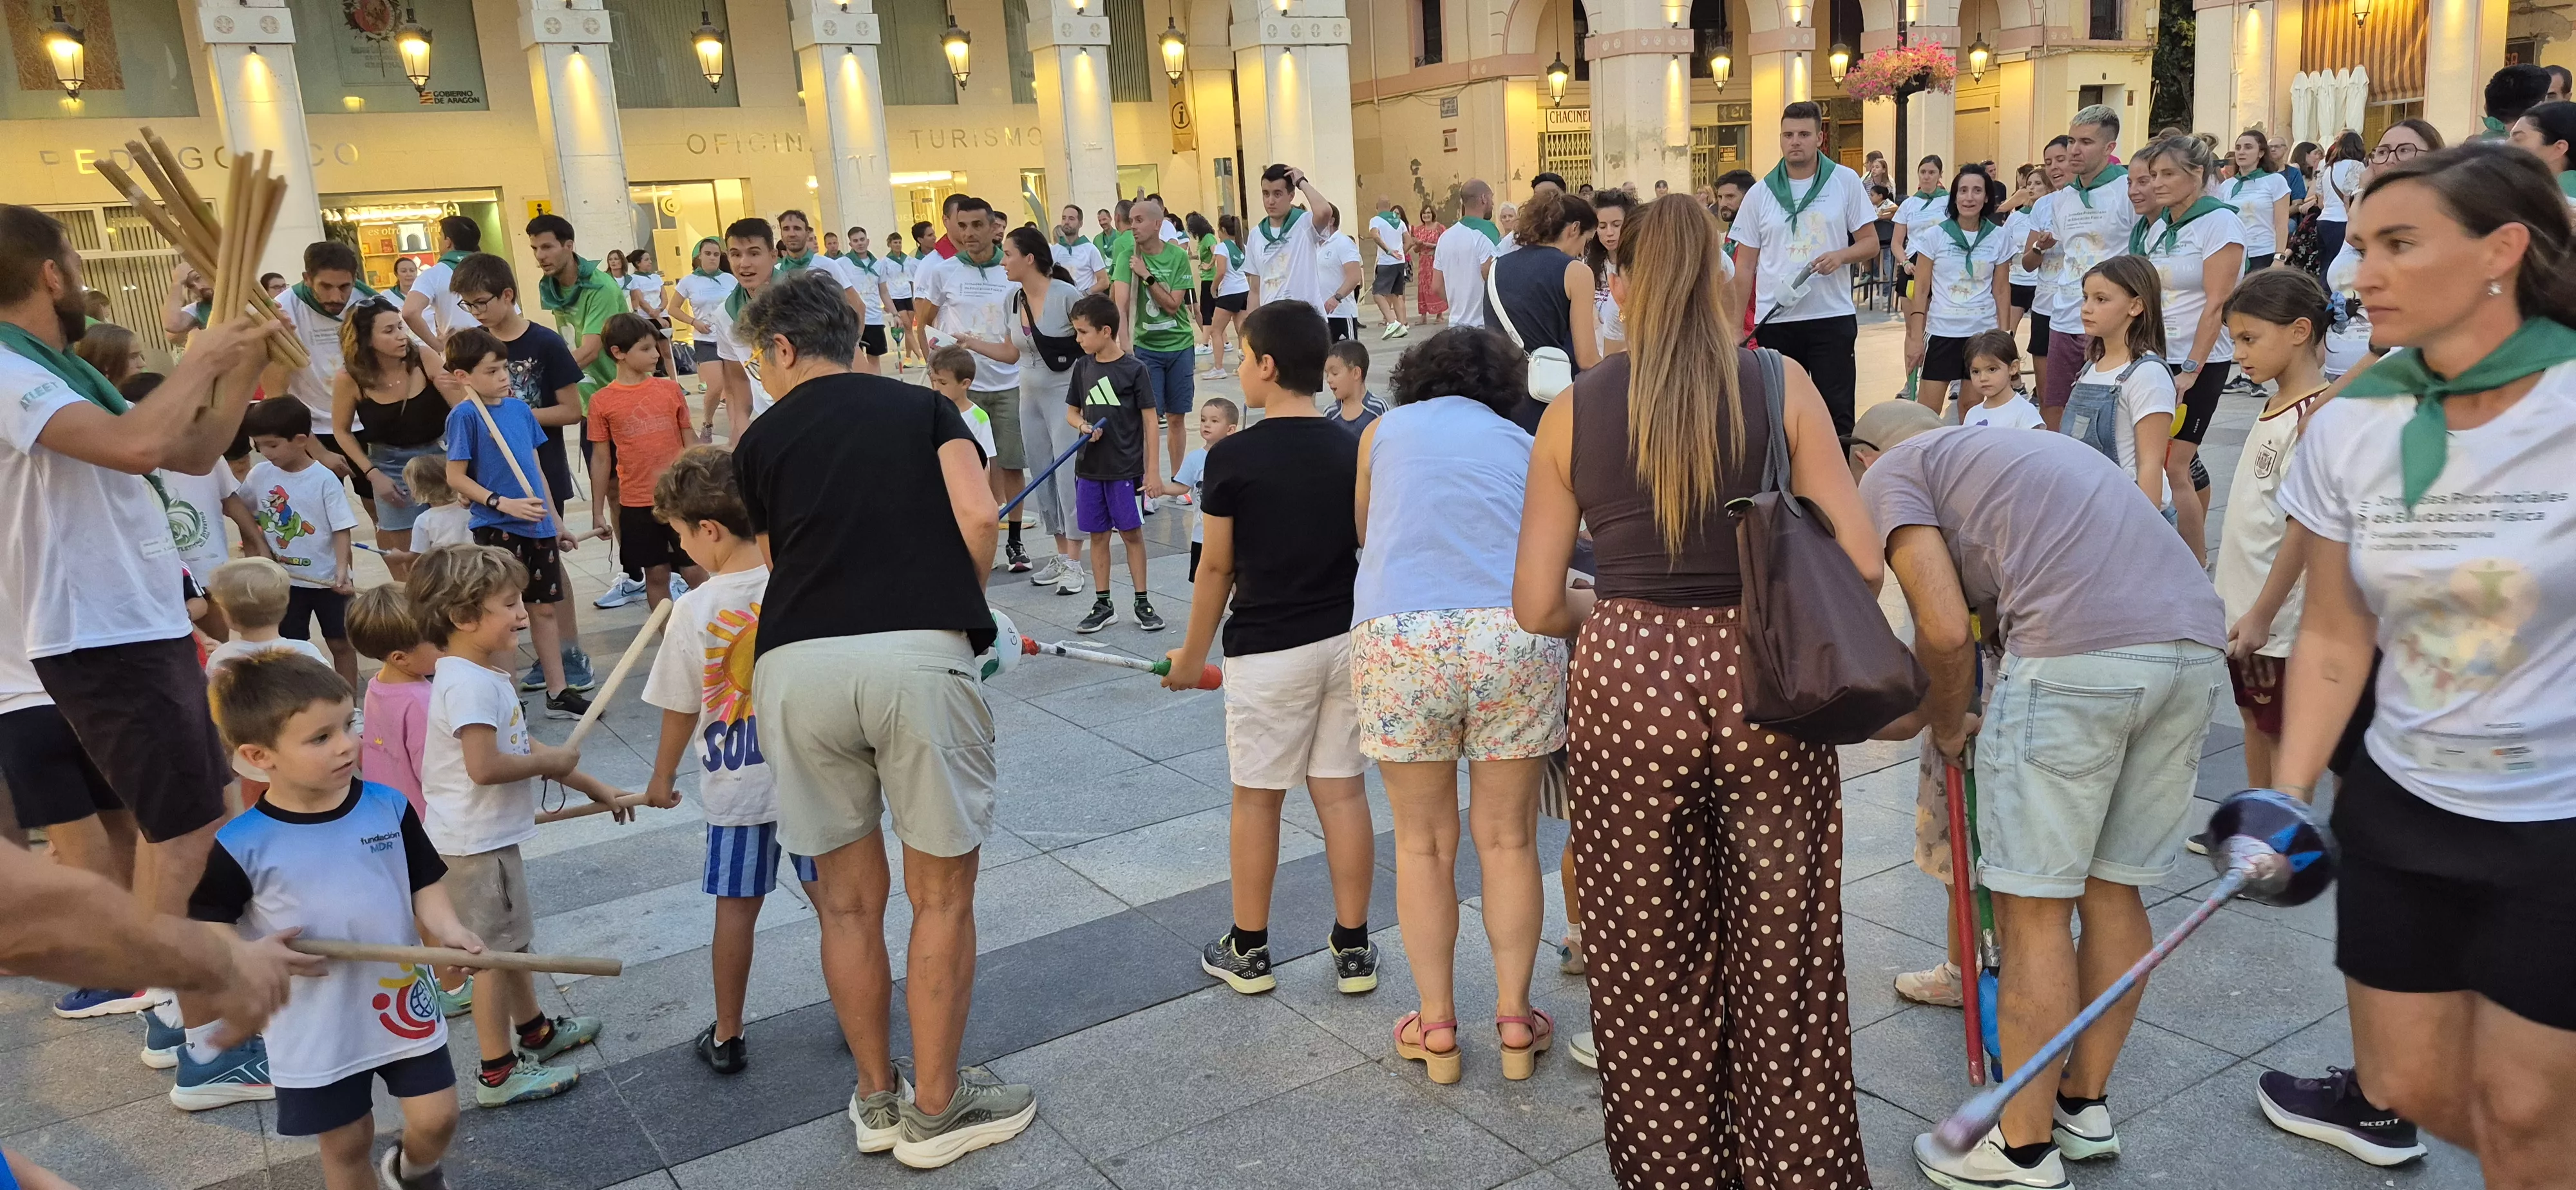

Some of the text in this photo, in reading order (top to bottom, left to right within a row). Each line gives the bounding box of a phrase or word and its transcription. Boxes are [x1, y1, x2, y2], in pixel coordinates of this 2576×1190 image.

[686, 126, 1043, 155] OFICIN TURISMO
[19, 381, 59, 412] ATLEET
[360, 831, 400, 845] fundación
[370, 841, 393, 854] MDR
[2359, 1118, 2400, 1127] SCOTT
